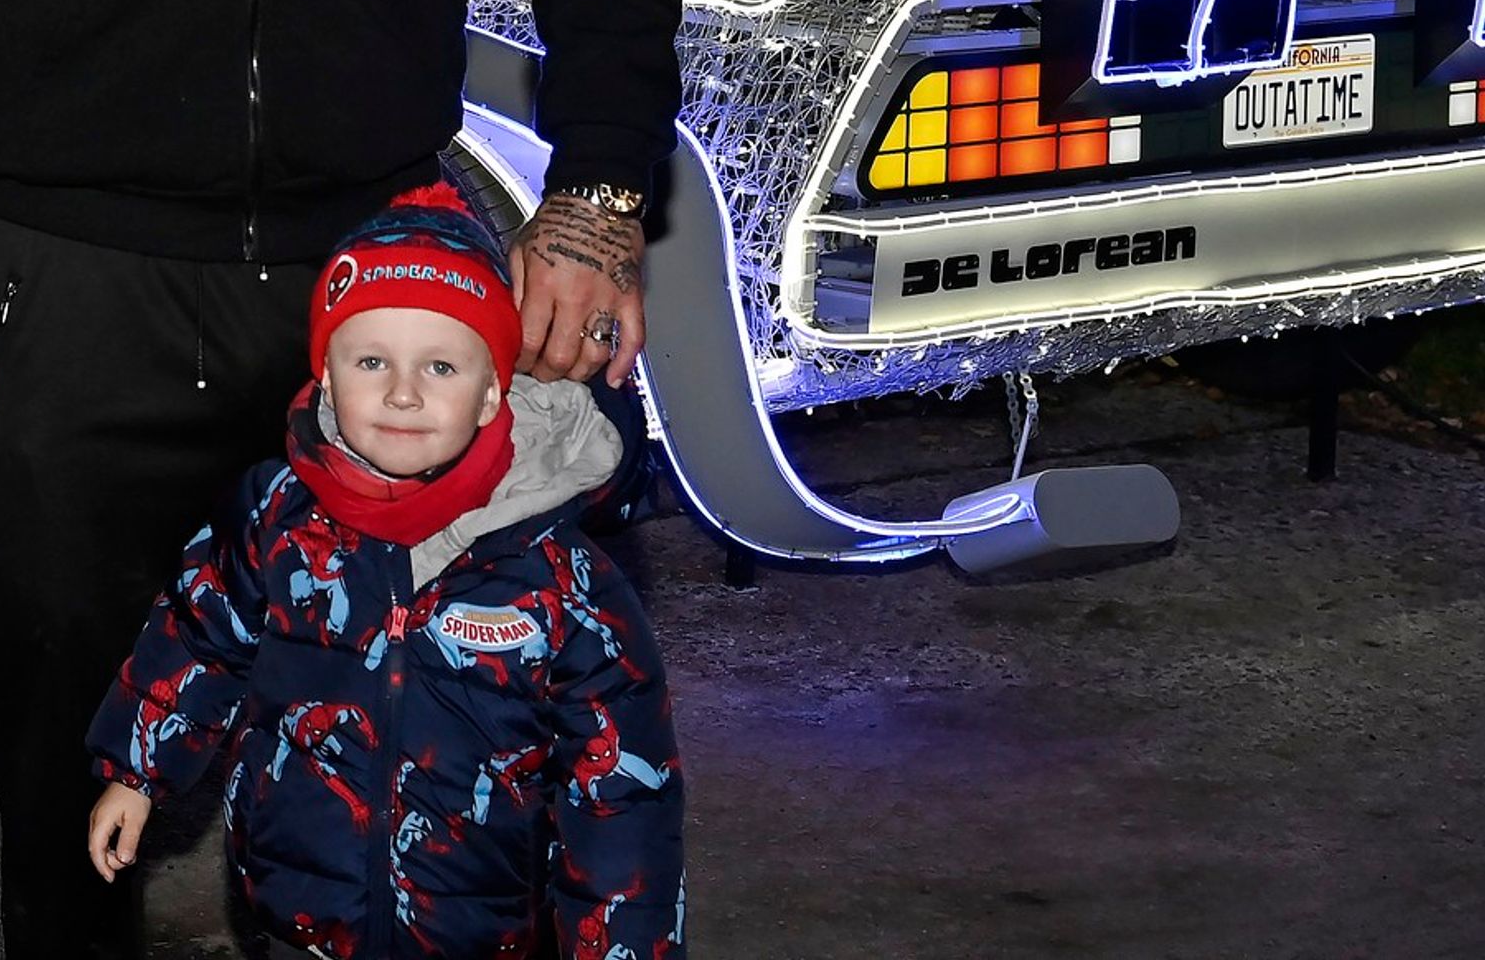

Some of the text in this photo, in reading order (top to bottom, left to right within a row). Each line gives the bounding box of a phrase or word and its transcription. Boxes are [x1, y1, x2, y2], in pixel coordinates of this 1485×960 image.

[1235, 73, 1363, 131] OUTATIME
[362, 264, 487, 300] SPIDER-MAN
[442, 617, 534, 642] SPIDER-MAN
